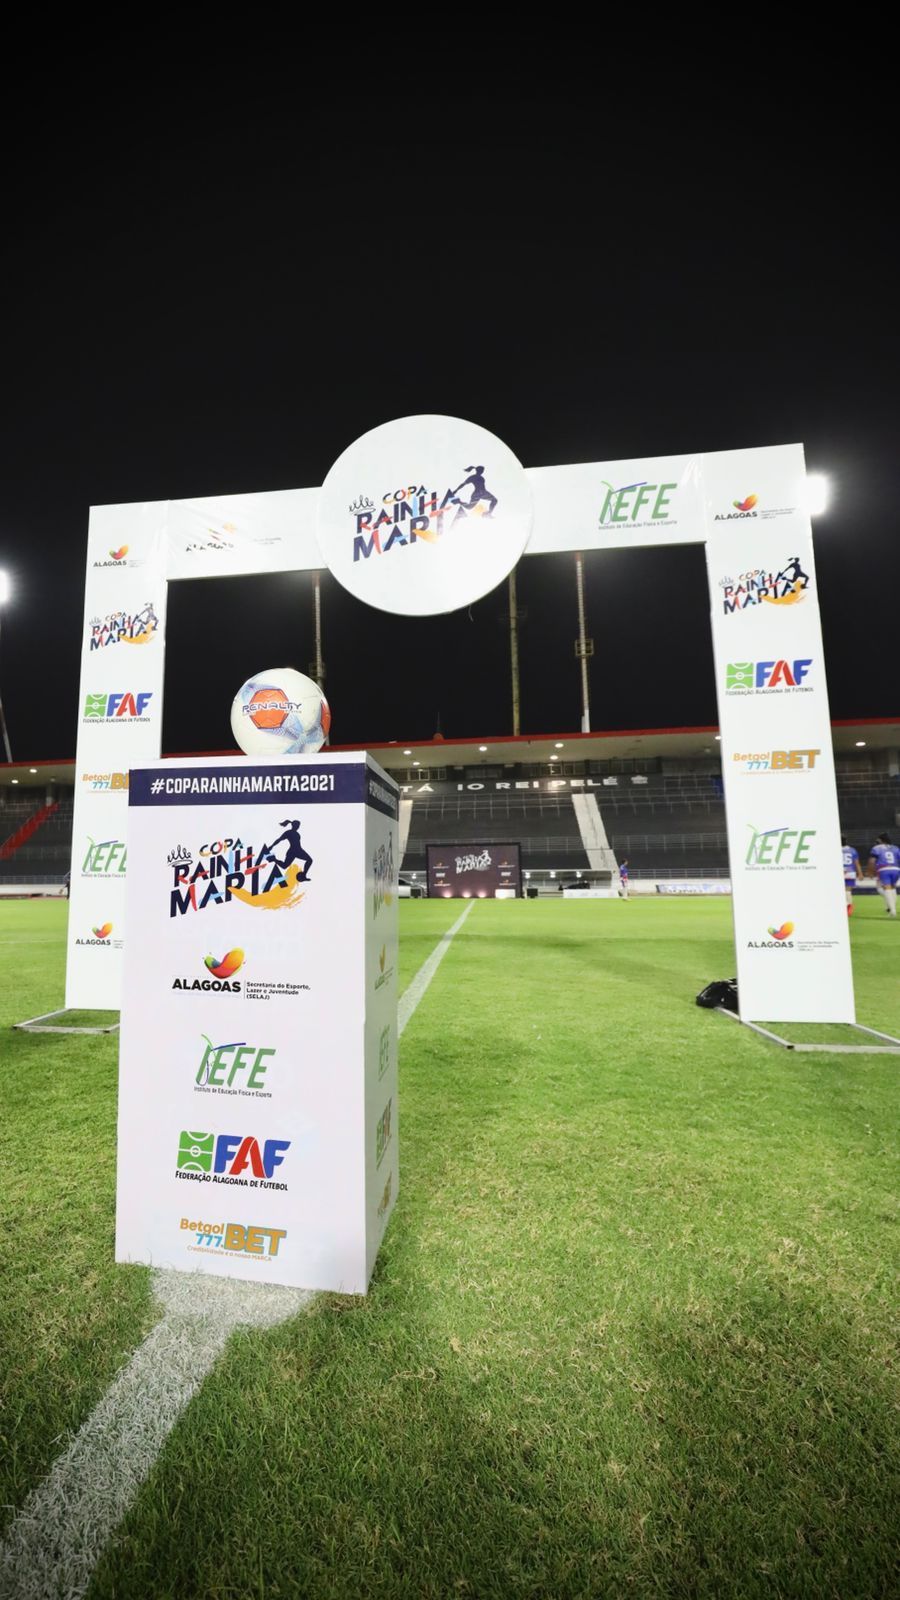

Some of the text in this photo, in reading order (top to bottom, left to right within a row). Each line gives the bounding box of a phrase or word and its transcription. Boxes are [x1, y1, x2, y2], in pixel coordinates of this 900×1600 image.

[383, 485, 427, 504] COPA
[598, 482, 677, 523] IEFE
[356, 488, 460, 534] RAINHA
[714, 511, 758, 521] ALAGOAS
[353, 506, 470, 562] MARTA
[724, 571, 784, 598] RAINHA
[739, 569, 767, 580] COPA
[723, 581, 797, 615] MARTA
[92, 614, 140, 637] RAINHA
[105, 611, 127, 622] COPA
[89, 623, 148, 651] MARTA
[755, 659, 813, 688] FAF
[106, 692, 153, 717] FAF
[242, 701, 302, 713] PENALTY
[733, 752, 770, 763] Betgol
[770, 749, 821, 770] BET
[82, 774, 111, 782] Betgol
[150, 774, 335, 795] #COPARAINHAMARTA2021
[496, 780, 540, 790] REI
[550, 776, 618, 788] PELÉ
[199, 837, 244, 857] COPA
[884, 851, 895, 864] 9
[174, 843, 275, 888] RAINHA
[170, 864, 290, 918] MARTA
[76, 938, 111, 947] ALAGOAS
[747, 941, 794, 949] ALAGOAS
[171, 978, 242, 994] ALAGOAS
[246, 993, 270, 1001] (SELAJ)
[195, 1044, 276, 1090] IEFE
[213, 1133, 291, 1180] FAF
[175, 1170, 289, 1191] FEDERAÇÃO ALAGOANA DE FUTEBOL
[179, 1217, 225, 1234] Betgol
[223, 1223, 287, 1256] BET
